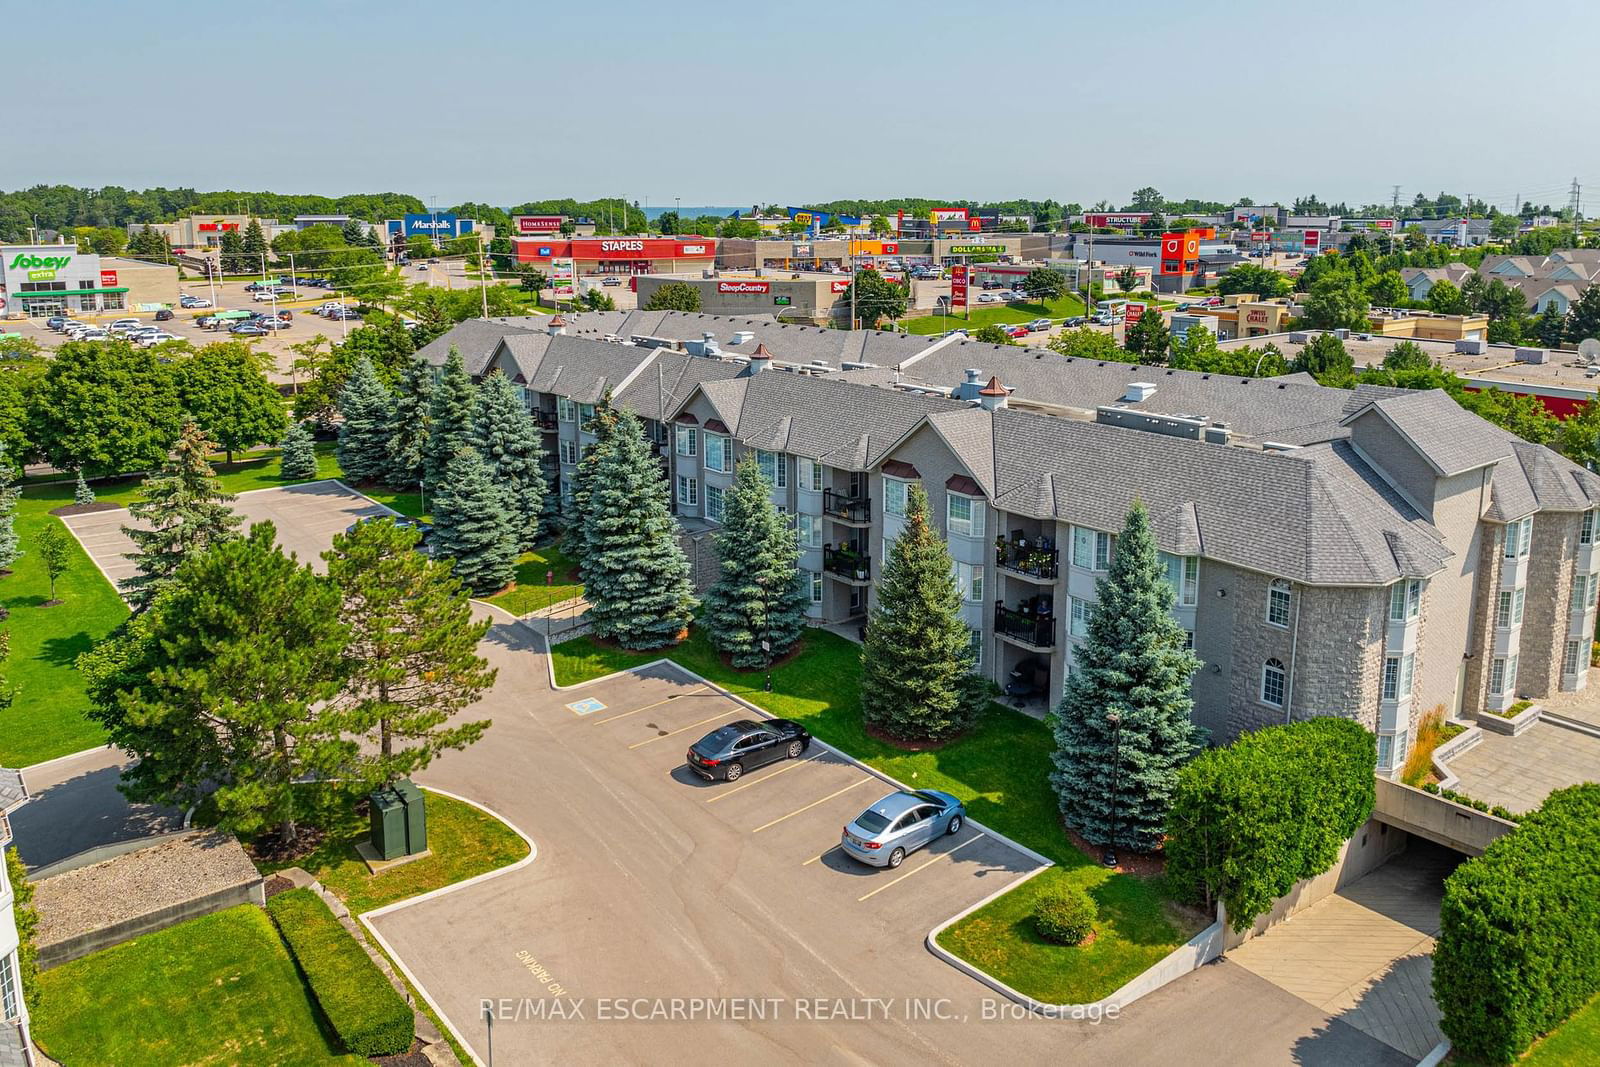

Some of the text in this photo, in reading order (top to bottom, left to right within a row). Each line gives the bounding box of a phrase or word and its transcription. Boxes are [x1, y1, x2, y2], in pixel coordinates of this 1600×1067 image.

[412, 220, 451, 229] Marshalls
[602, 241, 644, 251] STAPLES
[10, 253, 72, 270] Sobeys
[516, 950, 567, 997] NO PARKING
